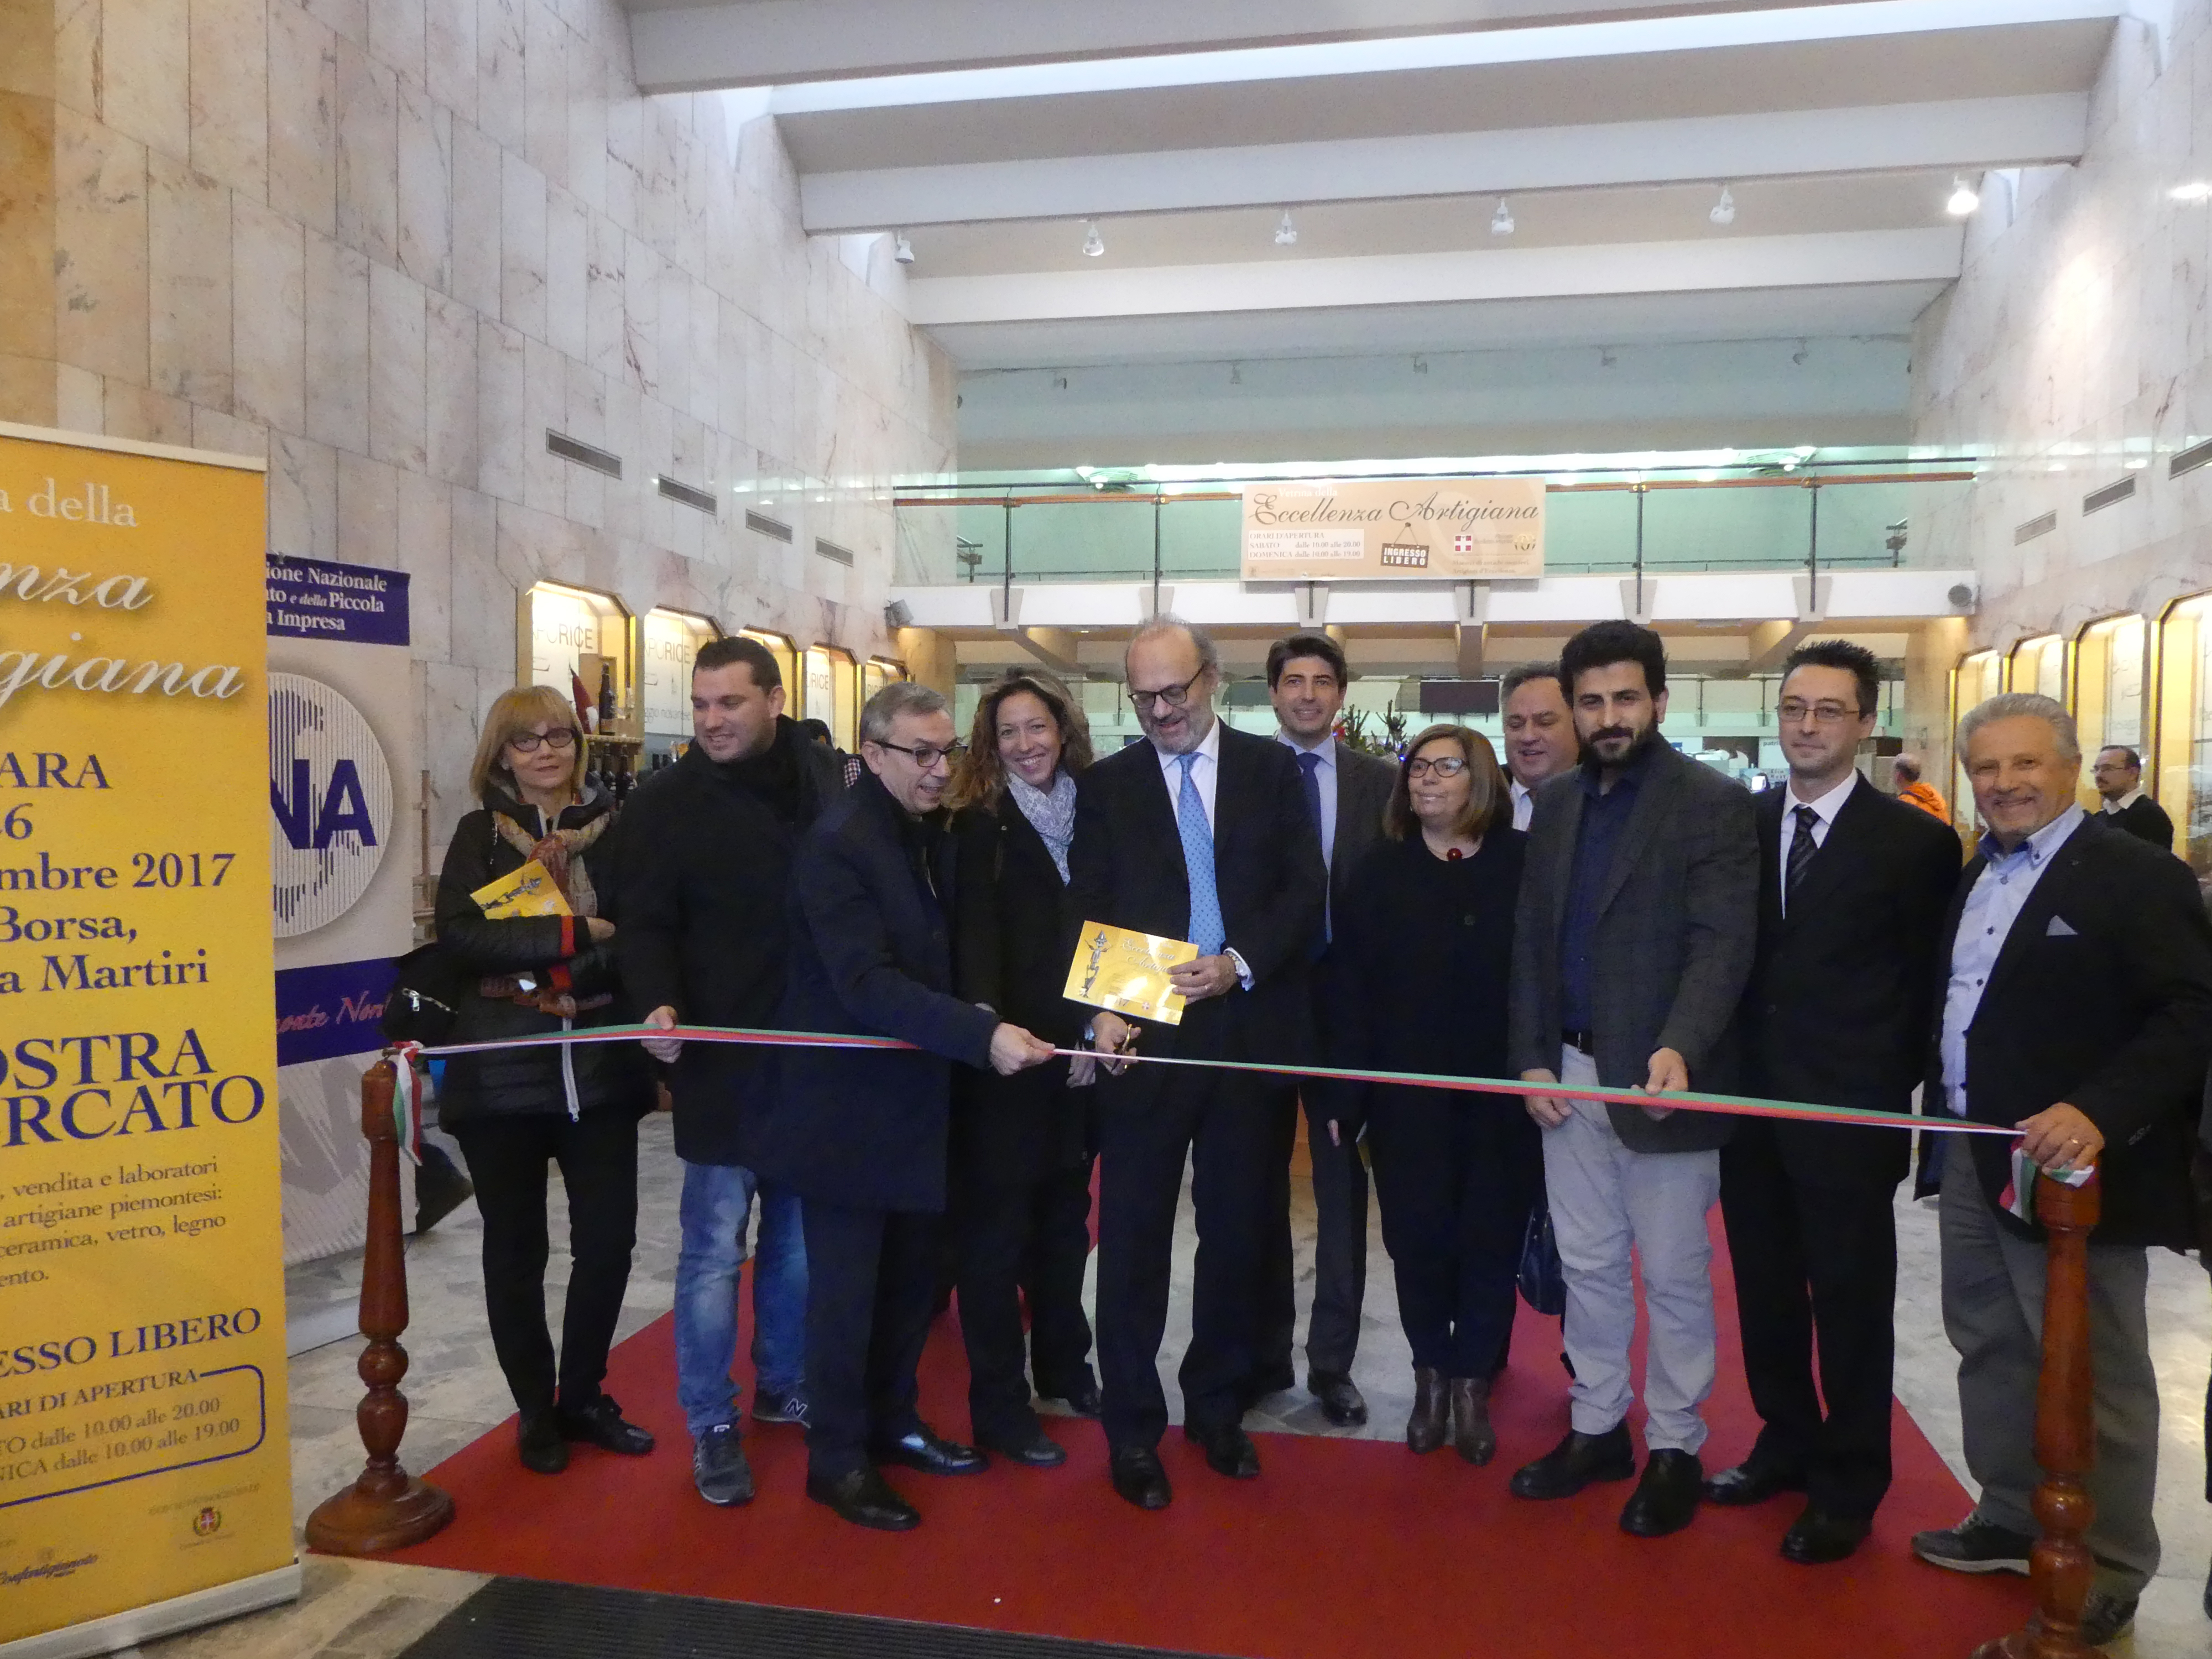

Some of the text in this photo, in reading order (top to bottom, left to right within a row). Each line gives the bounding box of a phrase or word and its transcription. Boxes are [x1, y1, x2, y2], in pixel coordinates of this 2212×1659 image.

[27, 477, 138, 527] della
[1248, 491, 1540, 532] Eccellenza Artigiana
[1278, 487, 1338, 497] Vetrina della
[1383, 556, 1426, 566] LIBERO
[1384, 547, 1426, 557] INGRESSO
[307, 567, 387, 592] Nazionale
[278, 609, 346, 633] Impresa
[290, 594, 297, 604] e
[299, 593, 328, 607] della
[329, 591, 385, 613] Piccola
[0, 752, 113, 790] ARA
[4, 803, 34, 839] 6
[0, 851, 236, 891] mbre 2017
[0, 905, 137, 945] Borsa,
[39, 948, 210, 992] Martiri
[0, 1027, 217, 1091] STRA
[0, 1075, 265, 1147] RCATO
[13, 1155, 218, 1196] vendita e laboratori
[3, 1183, 222, 1229] artigiane piemontesi:
[0, 1214, 226, 1258] ceramica, vetro, legno
[109, 1307, 262, 1359] LIBERO
[39, 1392, 67, 1412] DI
[72, 1369, 199, 1406] APERTURA
[30, 1426, 76, 1451] dalle
[84, 1414, 133, 1438] 10.00
[136, 1407, 167, 1428] alle
[172, 1397, 221, 1421] 20.00
[53, 1448, 98, 1471] dalle
[106, 1436, 153, 1459] 10.00
[157, 1429, 188, 1449] alle
[195, 1417, 240, 1442] 19.00
